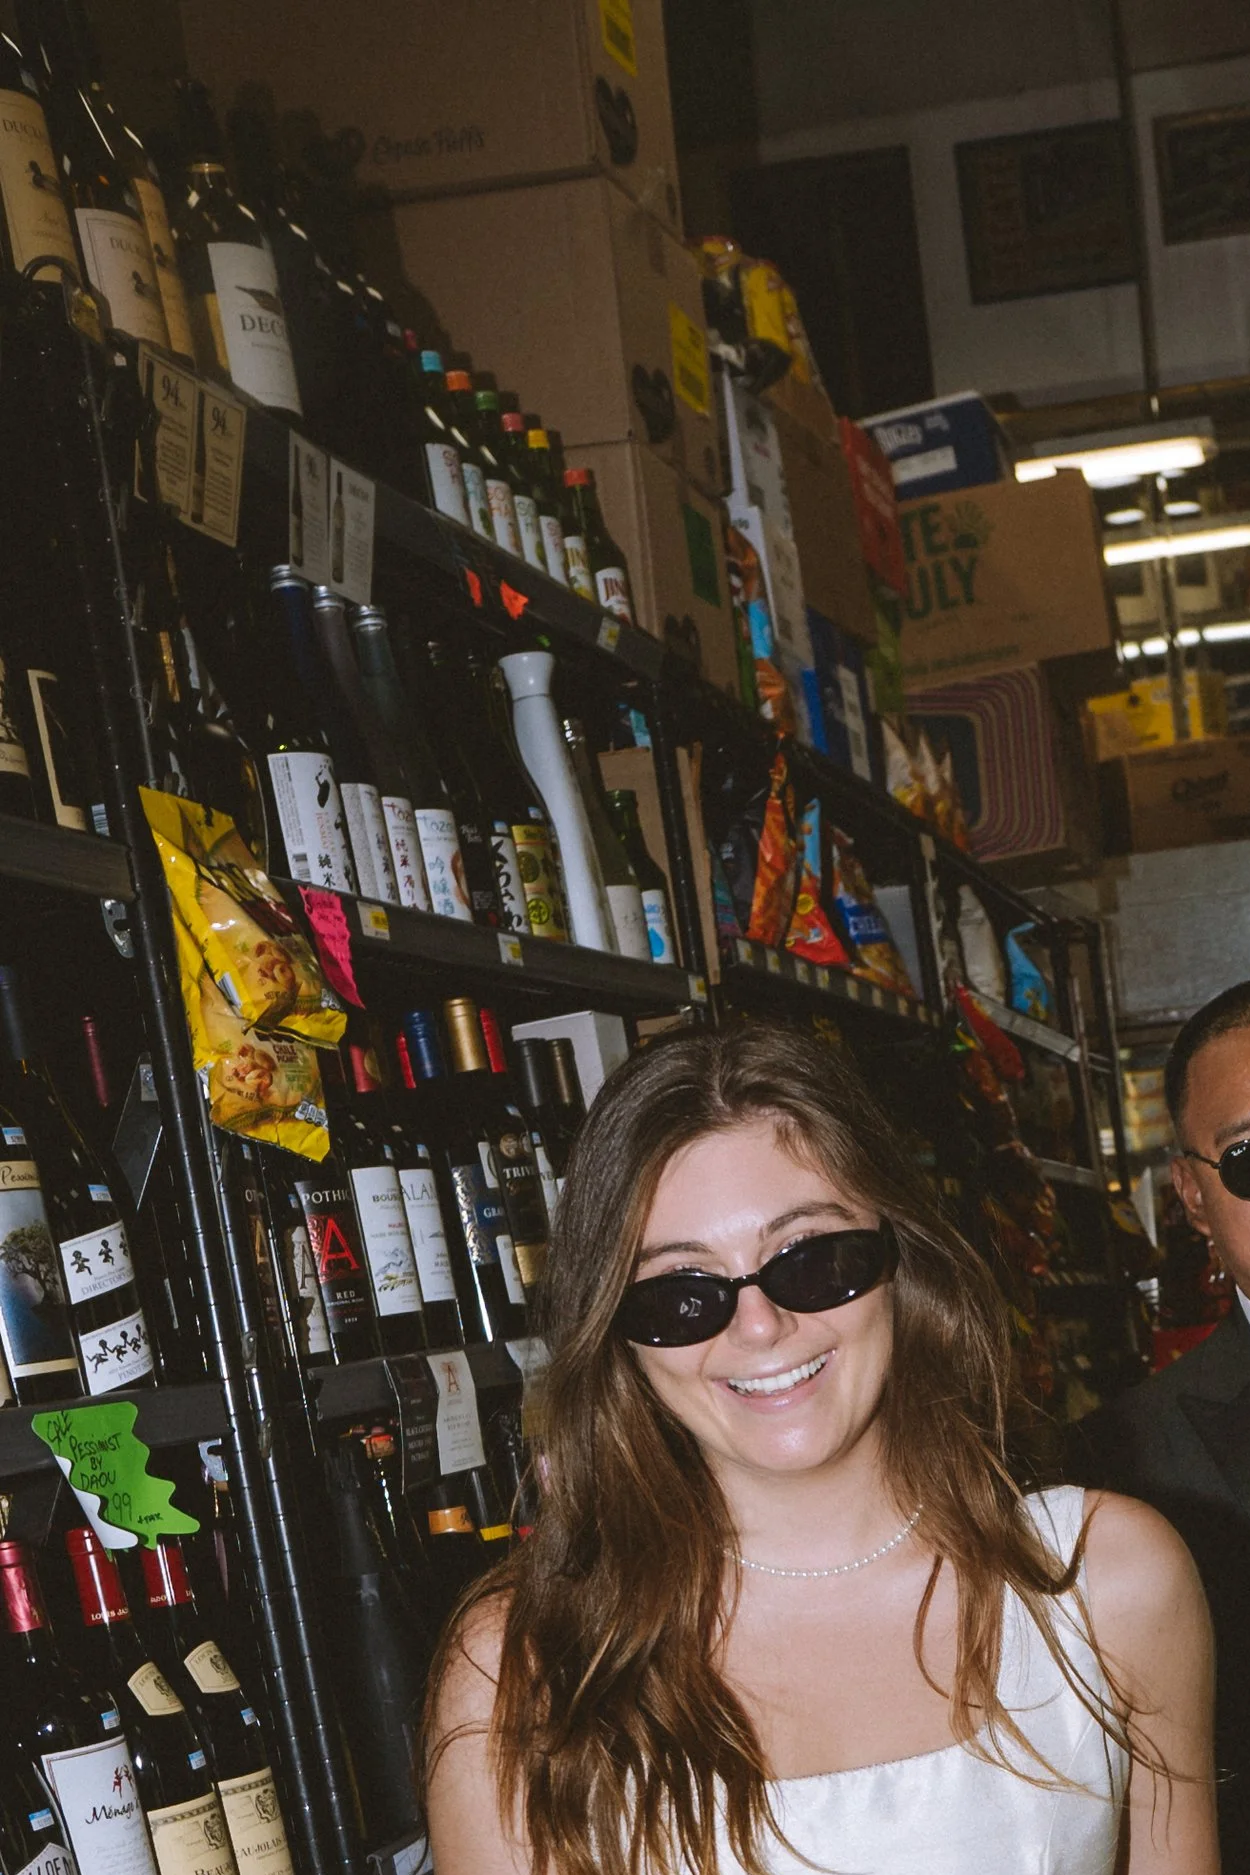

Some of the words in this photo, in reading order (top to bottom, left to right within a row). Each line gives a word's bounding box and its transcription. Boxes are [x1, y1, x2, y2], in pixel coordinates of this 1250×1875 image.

[319, 1217, 360, 1273] A
[90, 1456, 103, 1472] BY
[80, 1471, 117, 1492] DAOU
